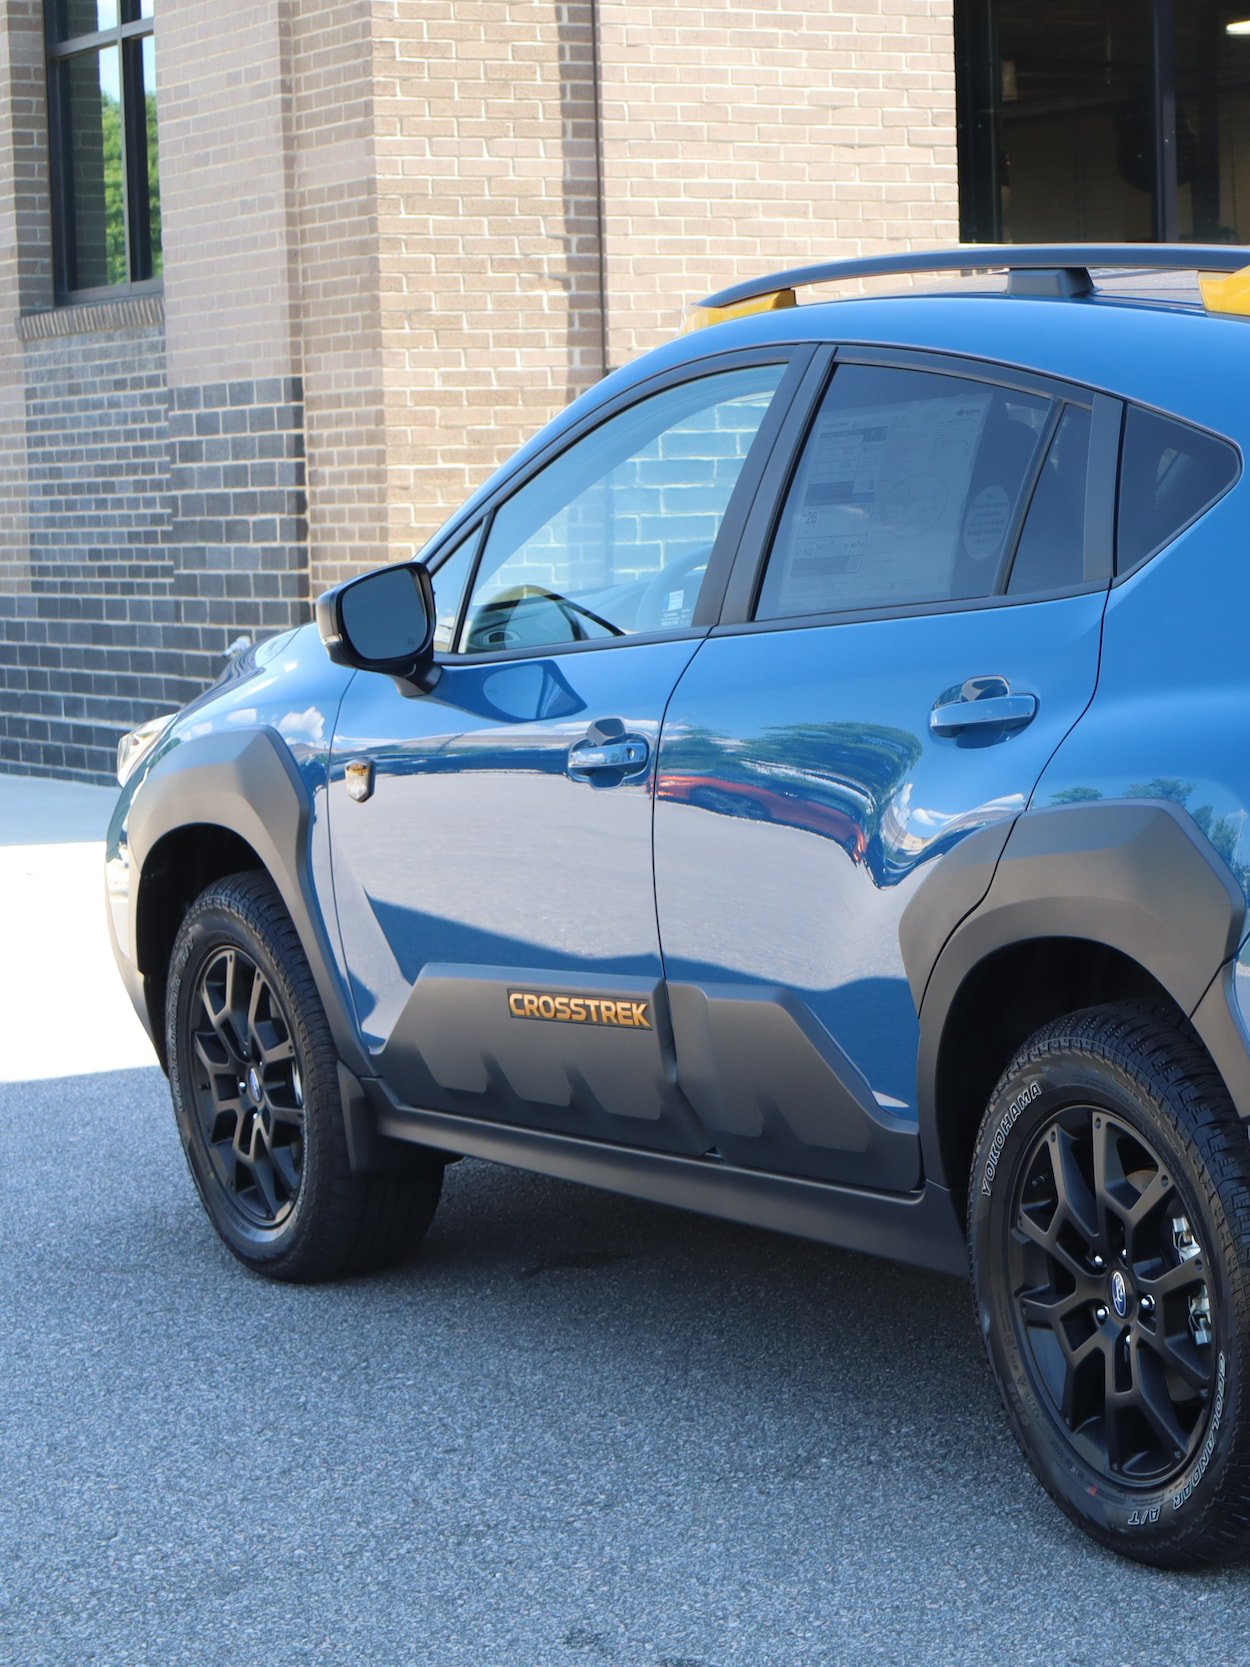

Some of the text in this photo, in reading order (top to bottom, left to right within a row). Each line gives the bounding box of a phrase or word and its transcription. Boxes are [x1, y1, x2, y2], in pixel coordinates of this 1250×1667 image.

[509, 993, 651, 1027] CROSSTREK
[981, 1080, 1042, 1197] YOKOHAMA
[1127, 1350, 1226, 1525] GEOLANDAR A/T
